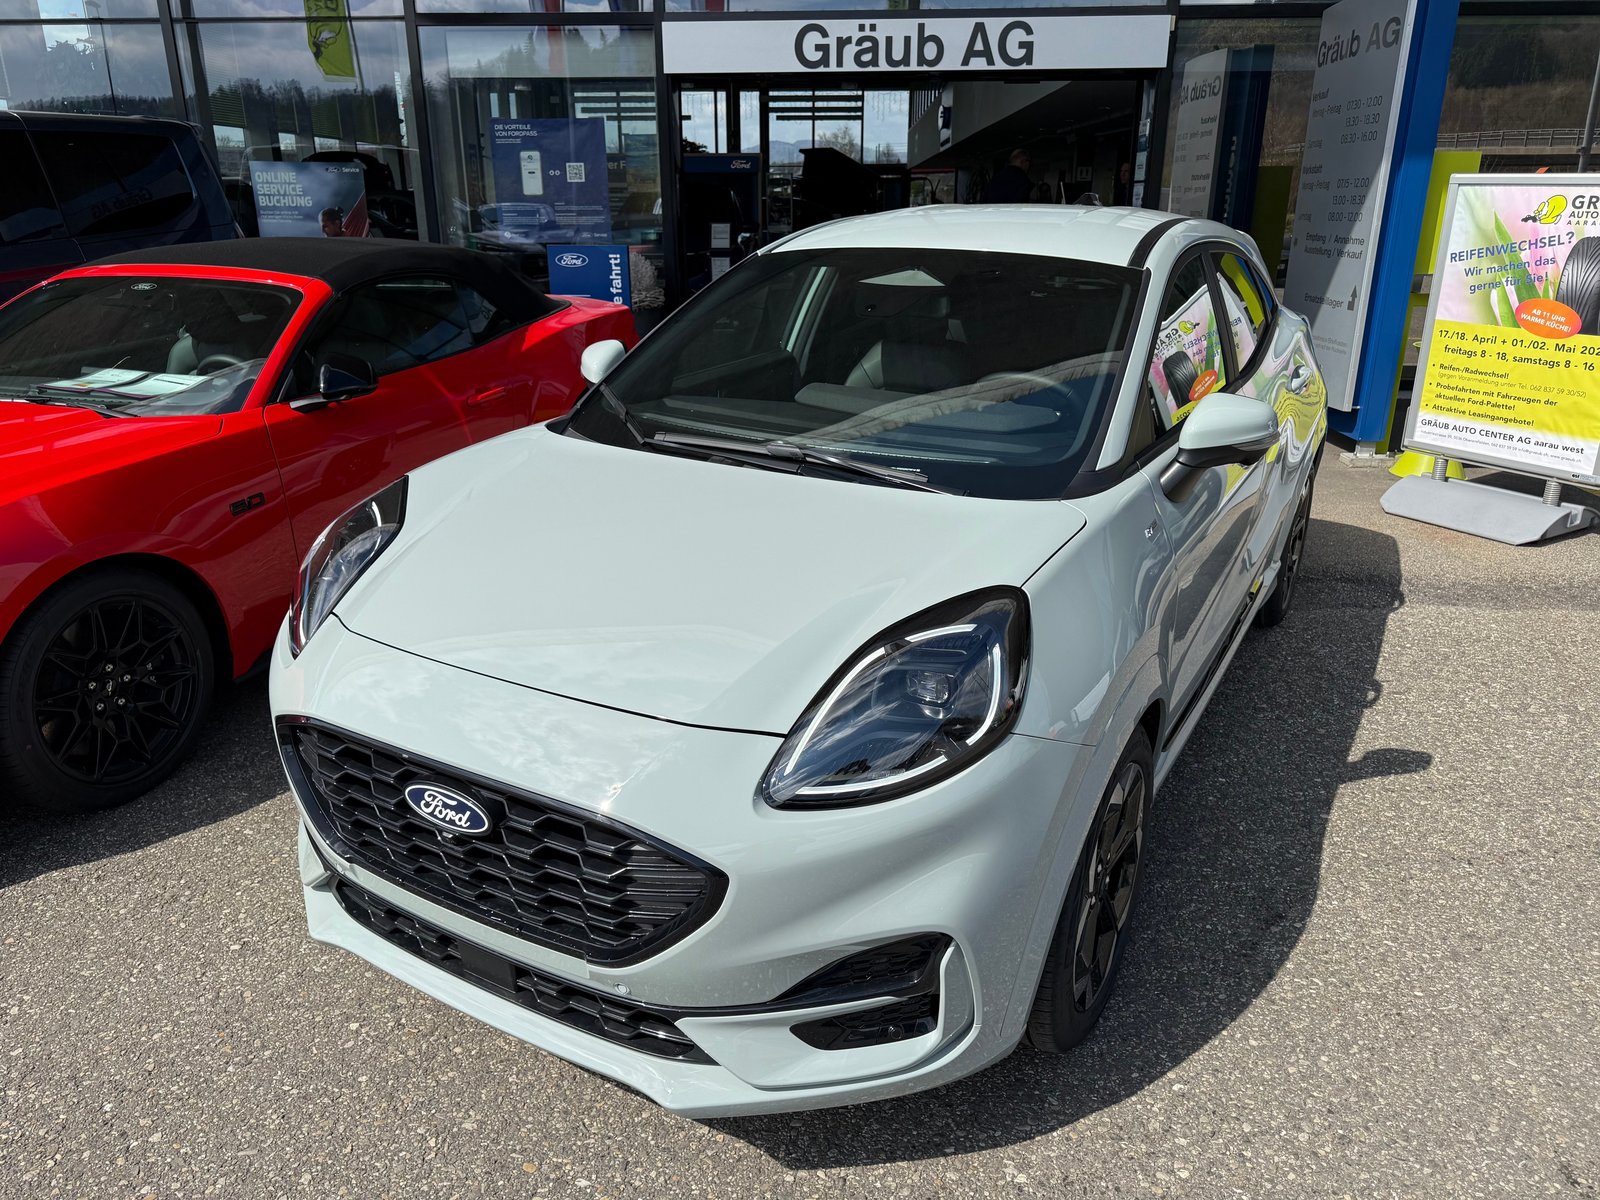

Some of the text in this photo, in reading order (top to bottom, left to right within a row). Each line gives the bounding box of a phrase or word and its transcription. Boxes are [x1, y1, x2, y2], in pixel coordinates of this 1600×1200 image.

[794, 20, 1035, 69] Gräub AG
[1317, 16, 1401, 68] Gräub AG
[1366, 95, 1383, 108] 12.00
[730, 159, 752, 169] Ford
[255, 172, 297, 183] ONLINE
[1354, 177, 1370, 188] 12.00
[257, 184, 303, 195] SERVICE
[258, 196, 313, 207] BUCHUNG
[1568, 211, 1600, 219] AUTO
[1334, 235, 1365, 246] Annahme
[1449, 231, 1575, 263] REIFENWECHSEL?
[1336, 248, 1363, 260] Verkauf
[608, 253, 623, 294] fahrt!
[1464, 255, 1556, 278] Wir machen das
[1469, 280, 1502, 294] gerne
[1504, 275, 1521, 287] für
[1520, 313, 1572, 333] WARME KÜCHE!
[1551, 314, 1566, 322] UHR
[1438, 329, 1468, 341] 17./18.
[1472, 334, 1498, 345] April
[1511, 338, 1549, 351] 01./02.
[1554, 343, 1577, 353] Mai
[1444, 344, 1478, 358] freitags
[1480, 349, 1487, 358] 8
[1496, 351, 1509, 362] 18,
[1512, 355, 1561, 369] samstags
[1564, 359, 1571, 369] 8
[1582, 361, 1595, 371] 16
[1439, 363, 1510, 379] Reifen-/Radwechsel!
[1437, 371, 1457, 380] (gegen
[1458, 374, 1499, 387] Voranmeldung
[1530, 384, 1542, 392] 062
[1556, 387, 1565, 395] 59
[1565, 389, 1587, 398] 30/52)
[1434, 392, 1516, 411] aktuellen Ford-Palette!
[1435, 382, 1480, 395] Probefahrten
[1496, 391, 1542, 404] Fahrzeugen
[1543, 399, 1558, 407] der
[1431, 403, 1535, 427] Attraktive Leasingangebote!
[1421, 418, 1585, 455] GRÄUB AUTO CENTER AG aarau west
